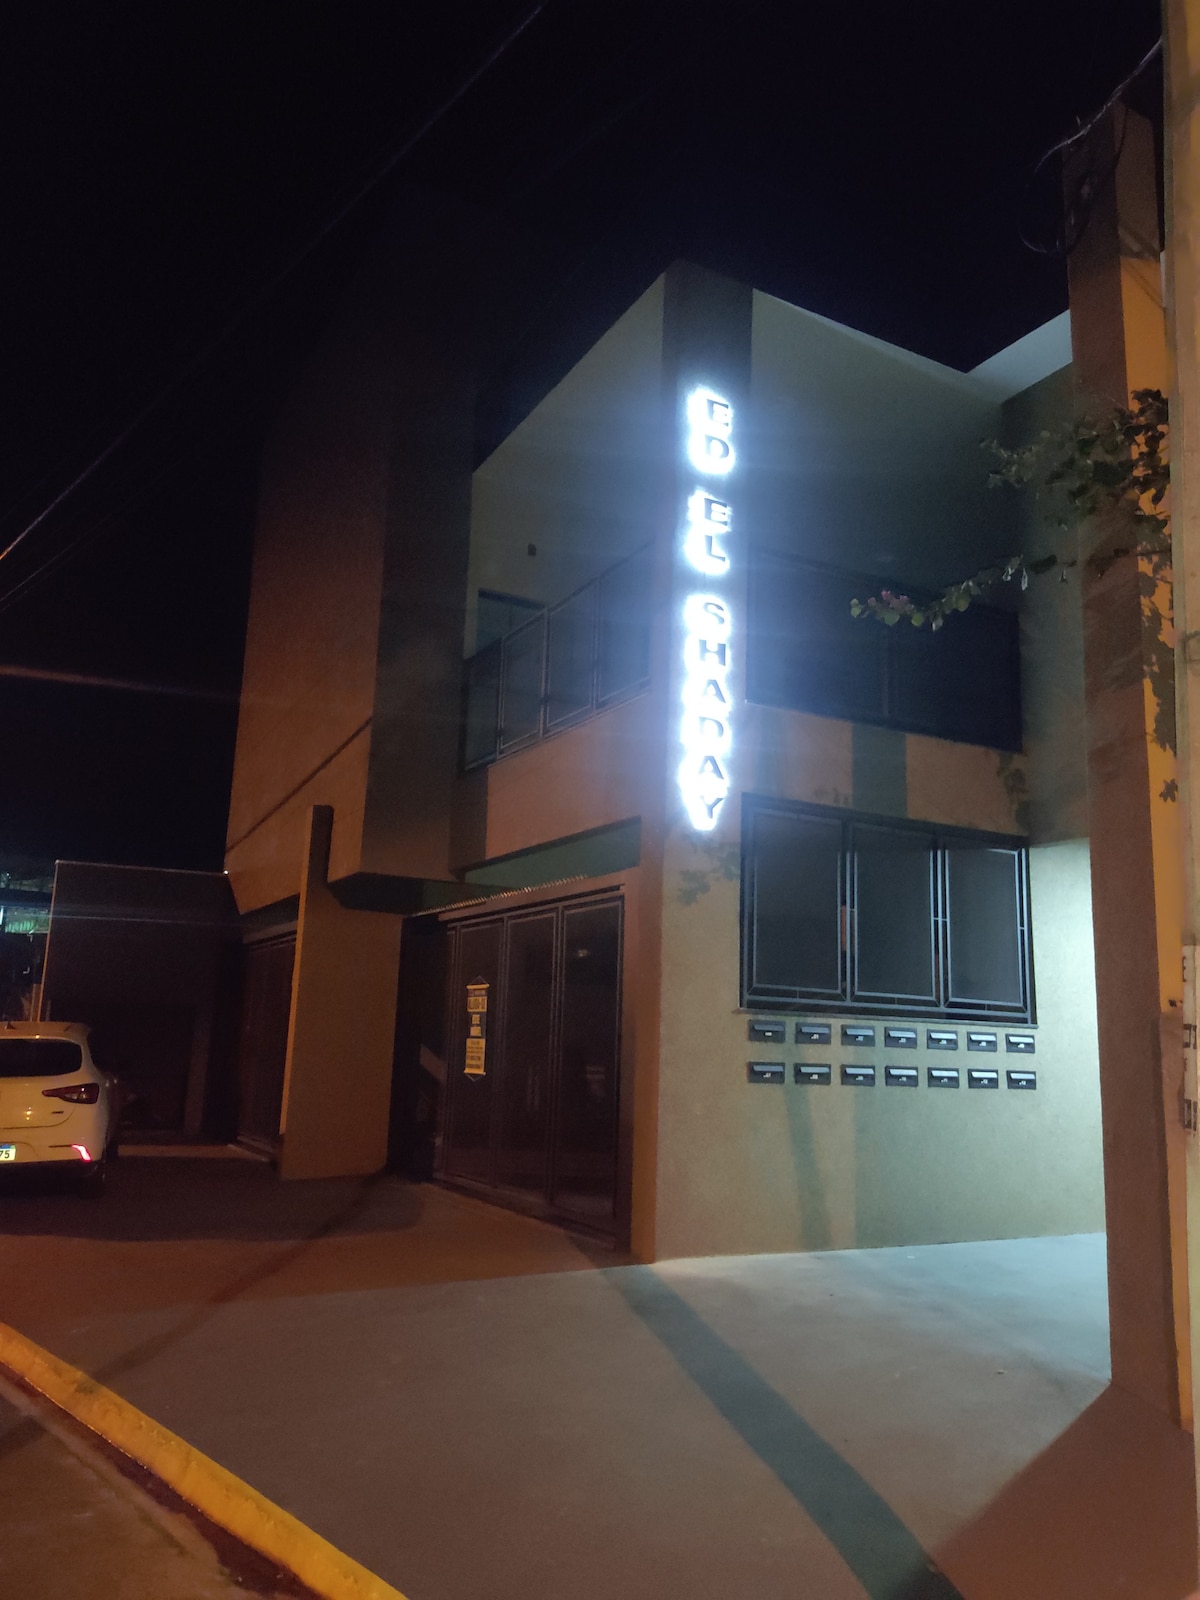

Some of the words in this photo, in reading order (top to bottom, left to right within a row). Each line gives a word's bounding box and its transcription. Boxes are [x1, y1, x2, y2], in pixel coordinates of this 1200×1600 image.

[705, 397, 730, 460] ED
[703, 497, 728, 563] EL
[698, 601, 727, 820] SHADAY
